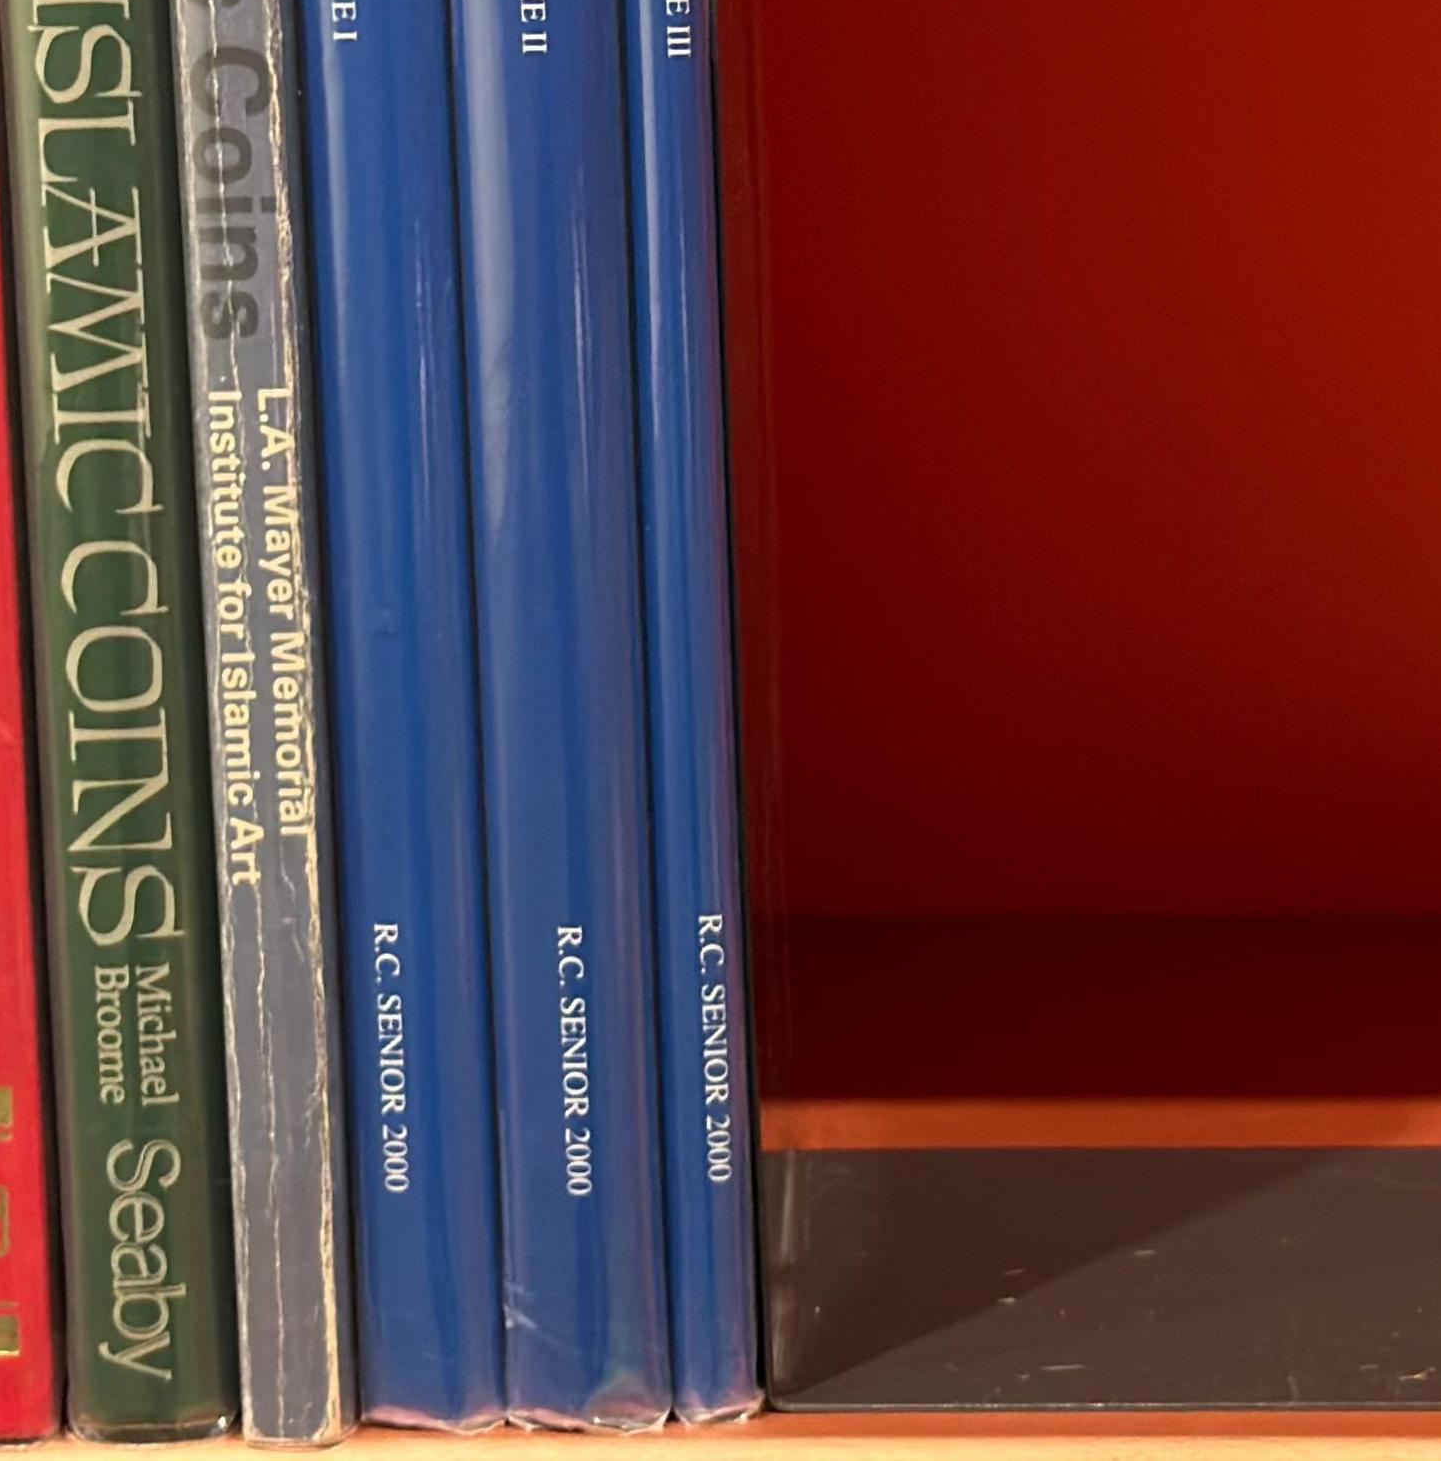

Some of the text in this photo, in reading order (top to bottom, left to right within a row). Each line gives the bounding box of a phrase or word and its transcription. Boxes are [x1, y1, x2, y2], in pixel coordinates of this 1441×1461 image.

[332, 31, 357, 41] I
[521, 32, 548, 55] II
[666, 25, 692, 58] III
[189, 46, 278, 340] Coins
[208, 389, 266, 886] Institute for Islamic Art
[259, 485, 299, 627] Mayer
[60, 540, 185, 946] COINS
[271, 631, 311, 837] Memorial
[94, 965, 130, 1105] Broome
[135, 962, 179, 1106] Michael
[374, 923, 409, 1193] R.C. SENIOR 2000
[557, 925, 593, 1197] R.C. SENIOR 2000
[698, 913, 732, 1183] R.C. SENIOR 2000
[98, 1139, 186, 1381] Seaby
